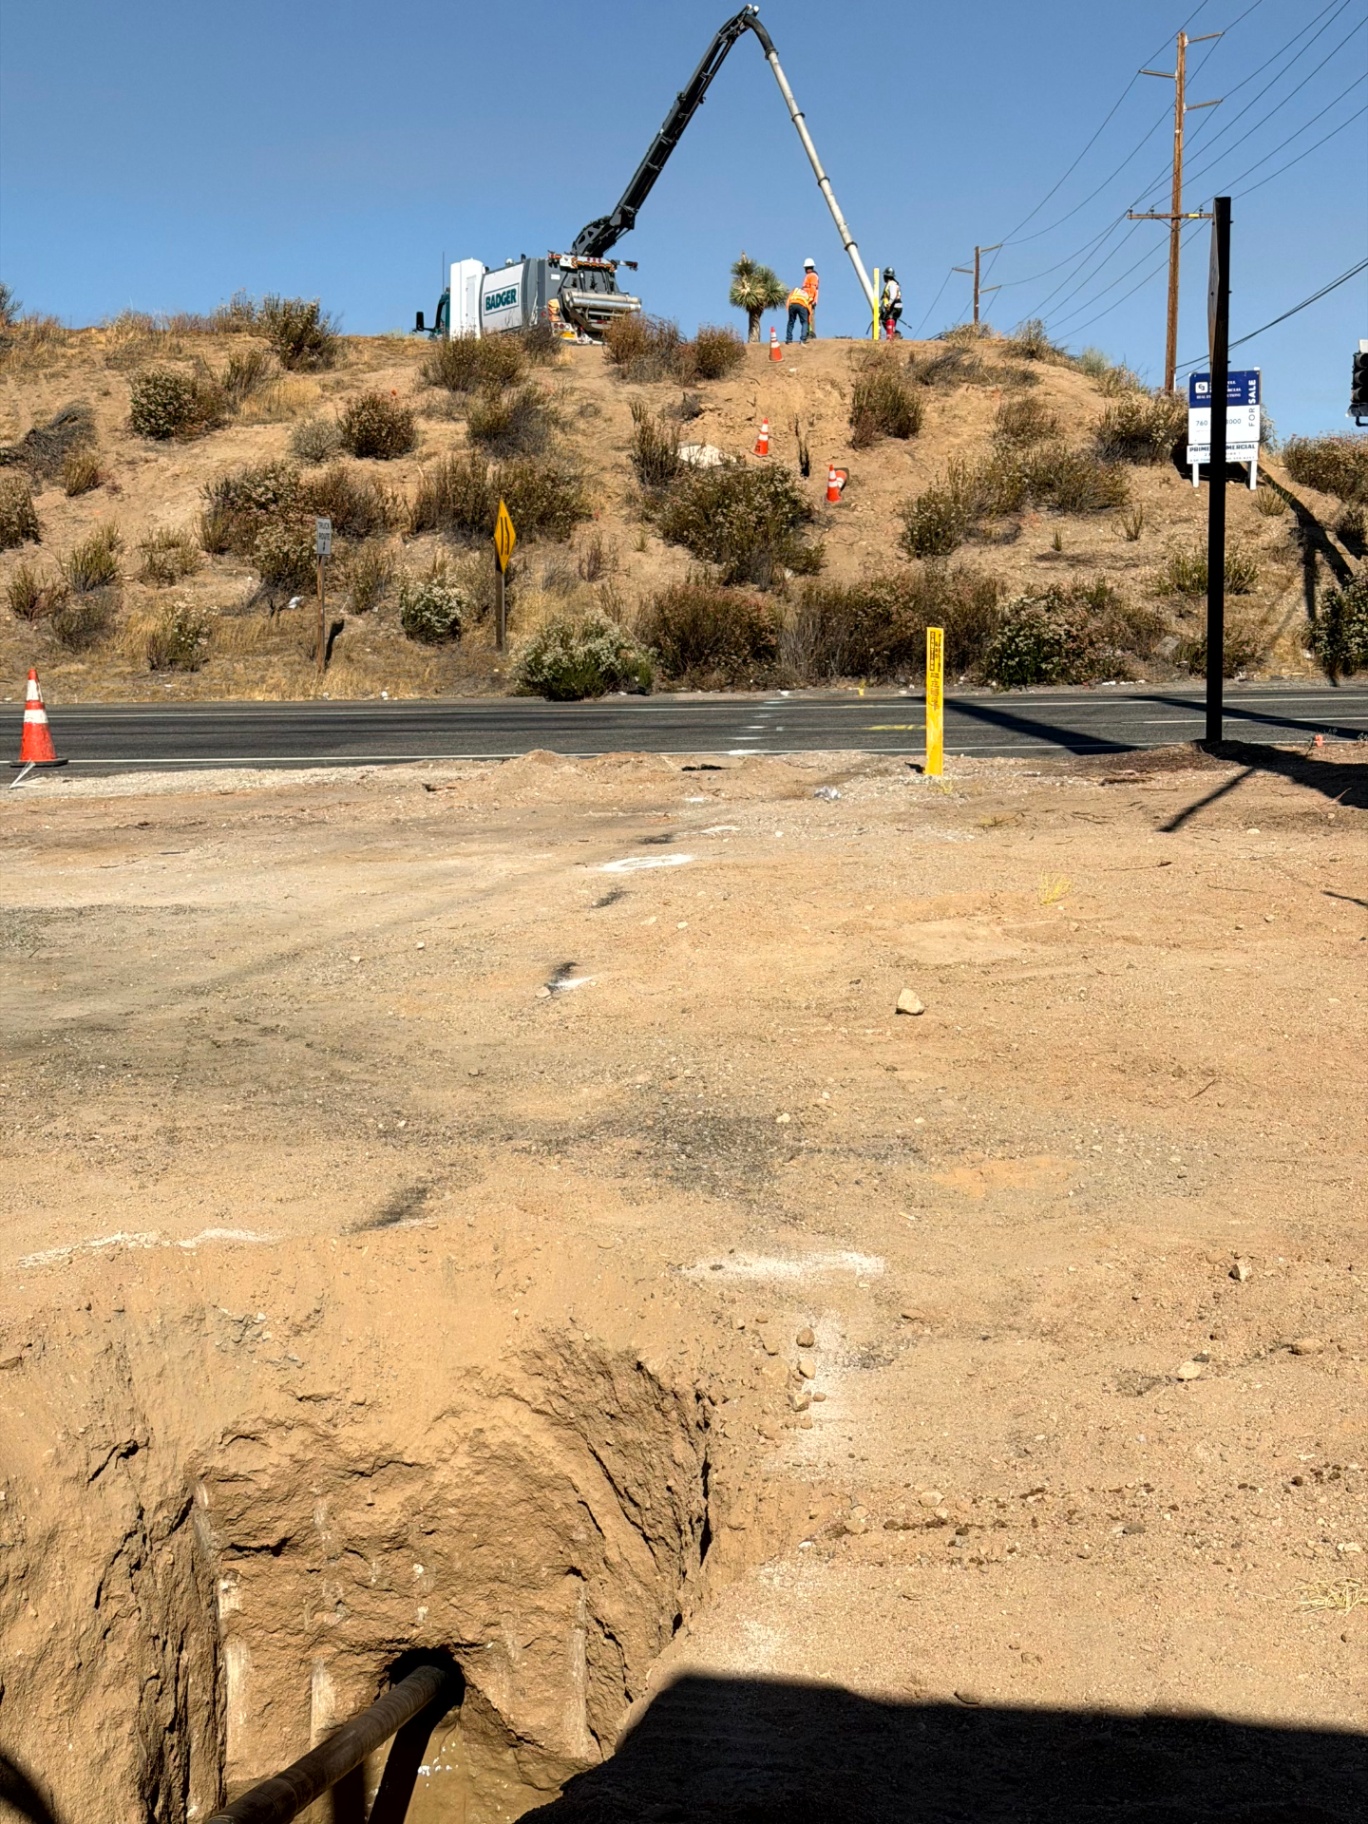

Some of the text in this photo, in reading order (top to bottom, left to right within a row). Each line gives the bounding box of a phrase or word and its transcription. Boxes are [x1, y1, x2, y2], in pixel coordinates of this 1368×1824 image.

[486, 288, 516, 311] BADGER
[1248, 380, 1256, 404] SALE
[318, 521, 330, 530] TRUCK
[318, 532, 330, 541] ROUTE
